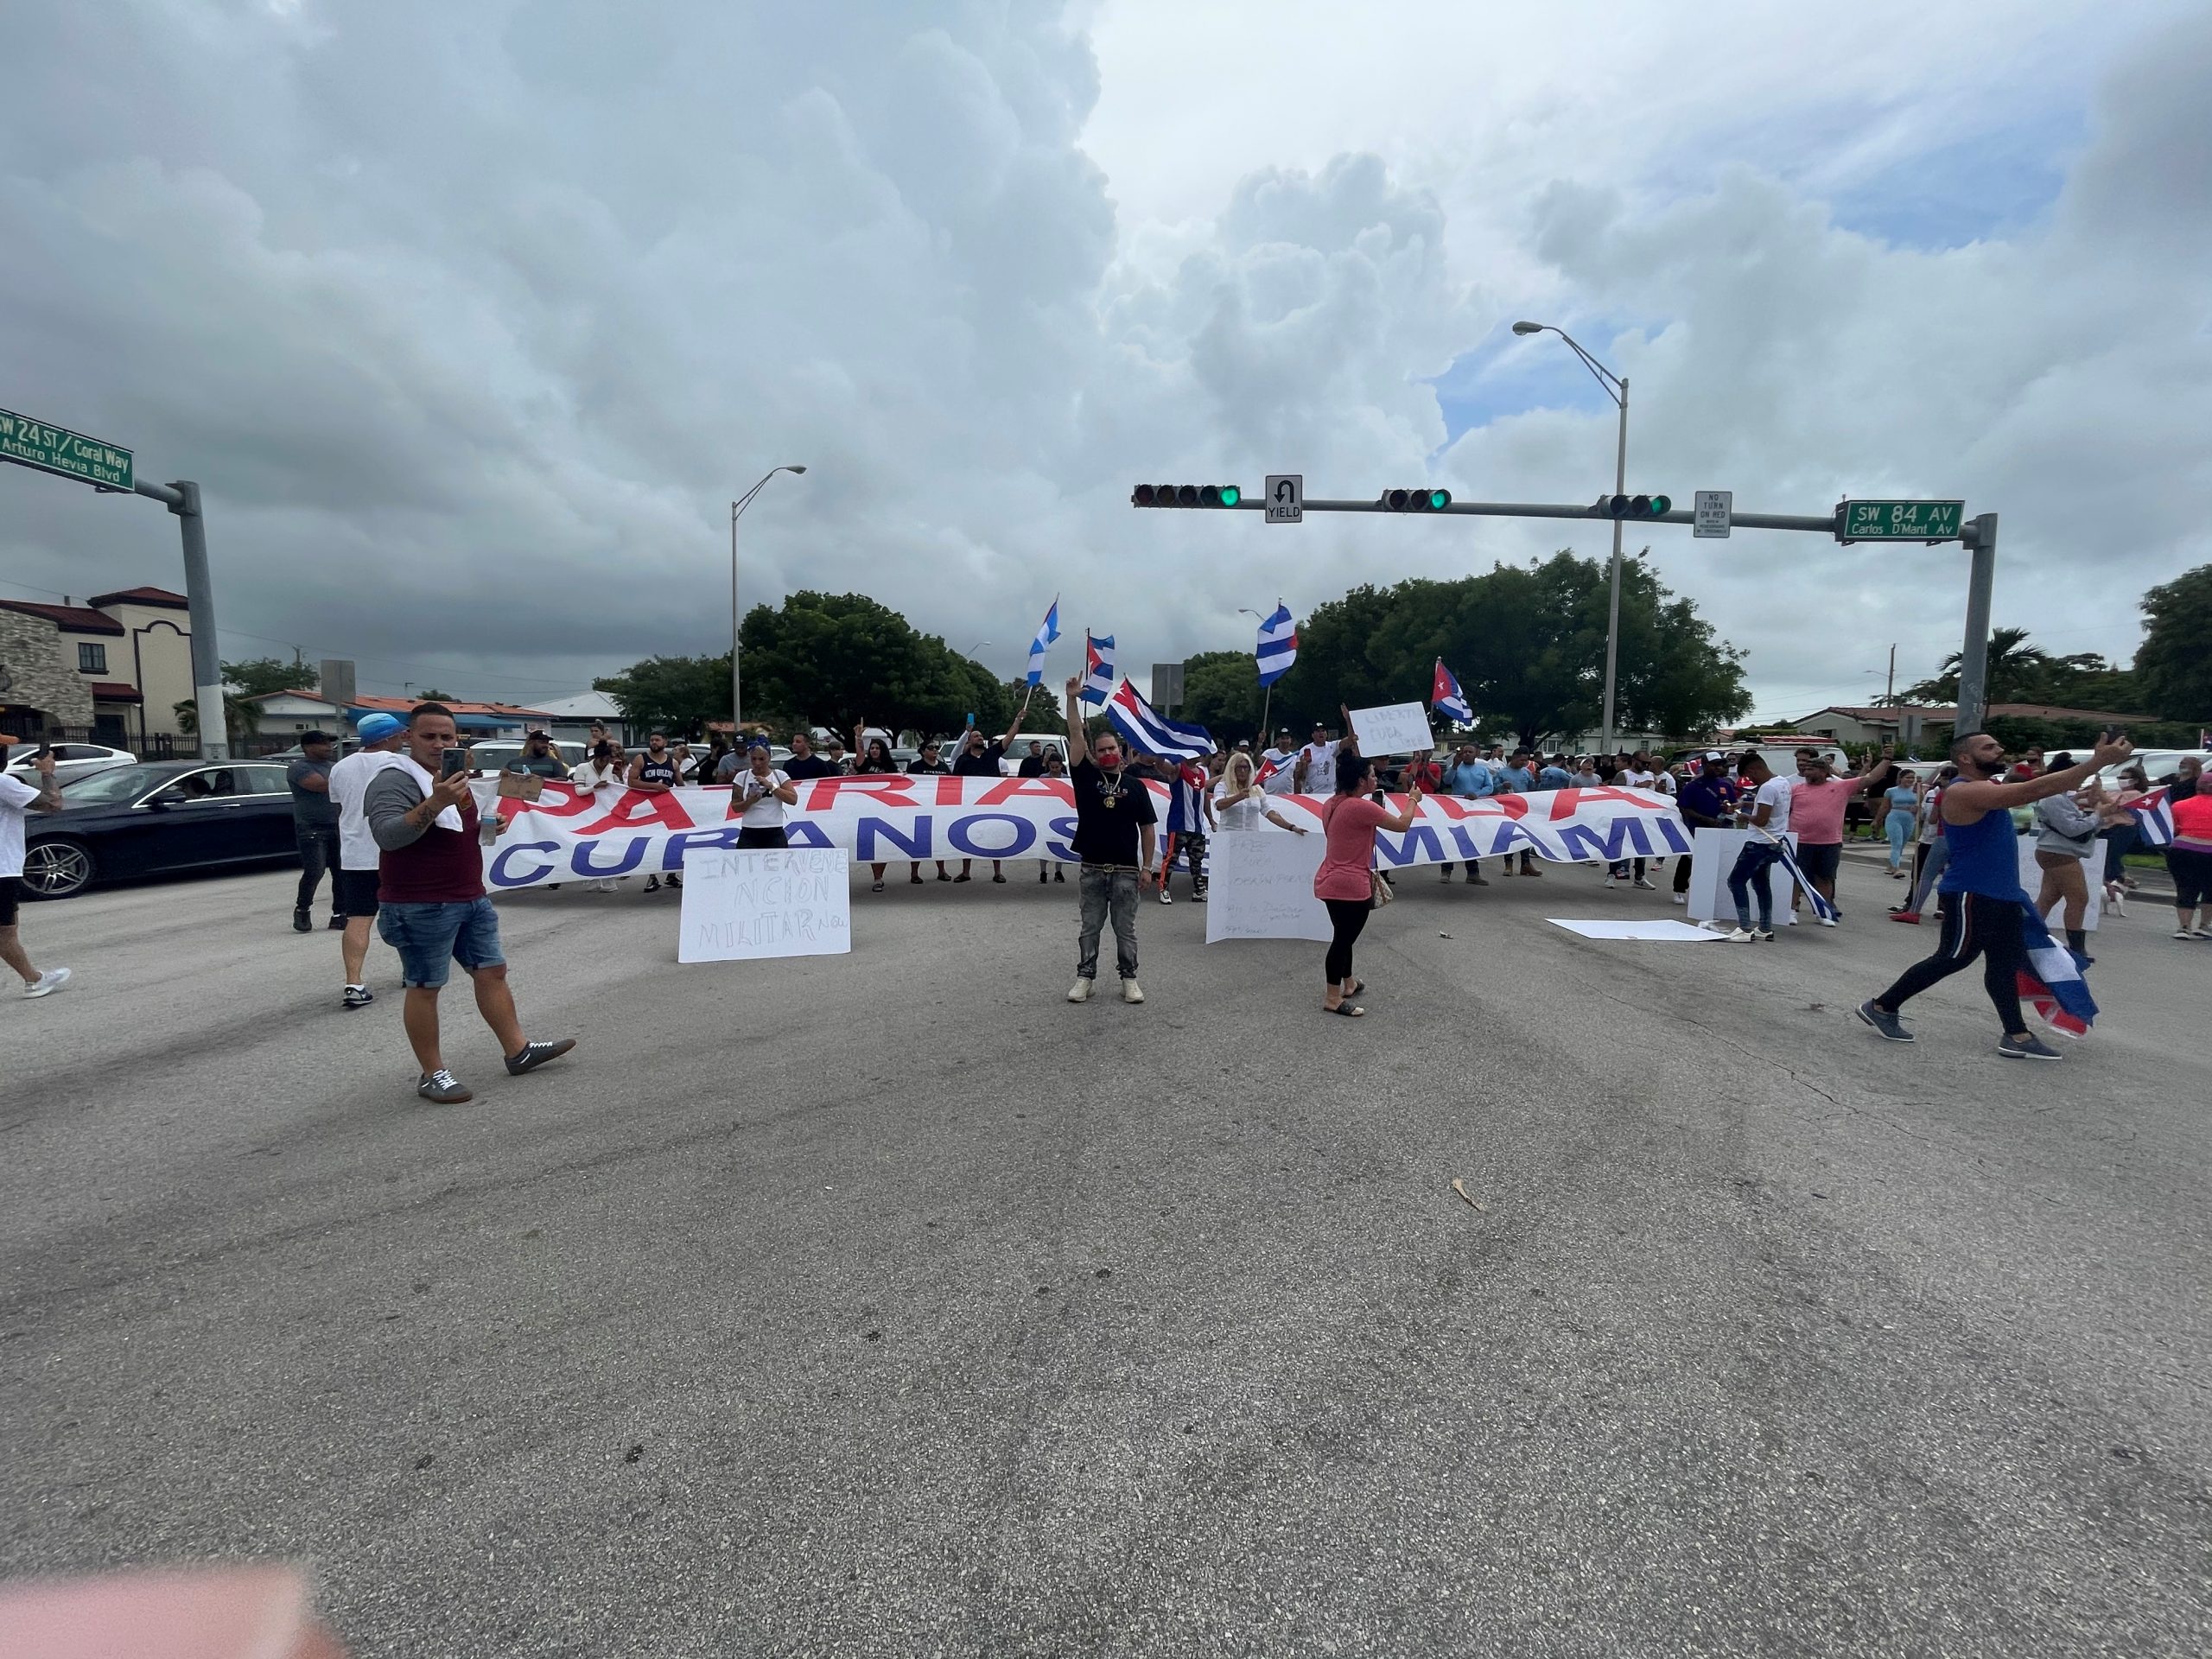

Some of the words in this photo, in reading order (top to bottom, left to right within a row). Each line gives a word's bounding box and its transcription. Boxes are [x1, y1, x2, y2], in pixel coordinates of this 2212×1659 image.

[2, 437, 46, 461] Arturo
[52, 451, 88, 474] Hevia
[93, 464, 120, 483] Blvd
[17, 420, 40, 446] 24
[73, 440, 103, 462] Coral
[105, 448, 129, 474] Way
[1268, 506, 1300, 518] YIELD
[1704, 501, 1723, 510] TURN
[1857, 506, 1880, 522] SW
[1891, 505, 1918, 524] 84
[1928, 506, 1953, 522] AV
[1852, 523, 1884, 535] Carlos
[1936, 523, 1953, 535] Av
[1370, 817, 1691, 865] MIAMI
[734, 874, 830, 908] NCION
[698, 908, 817, 950] MILITAR
